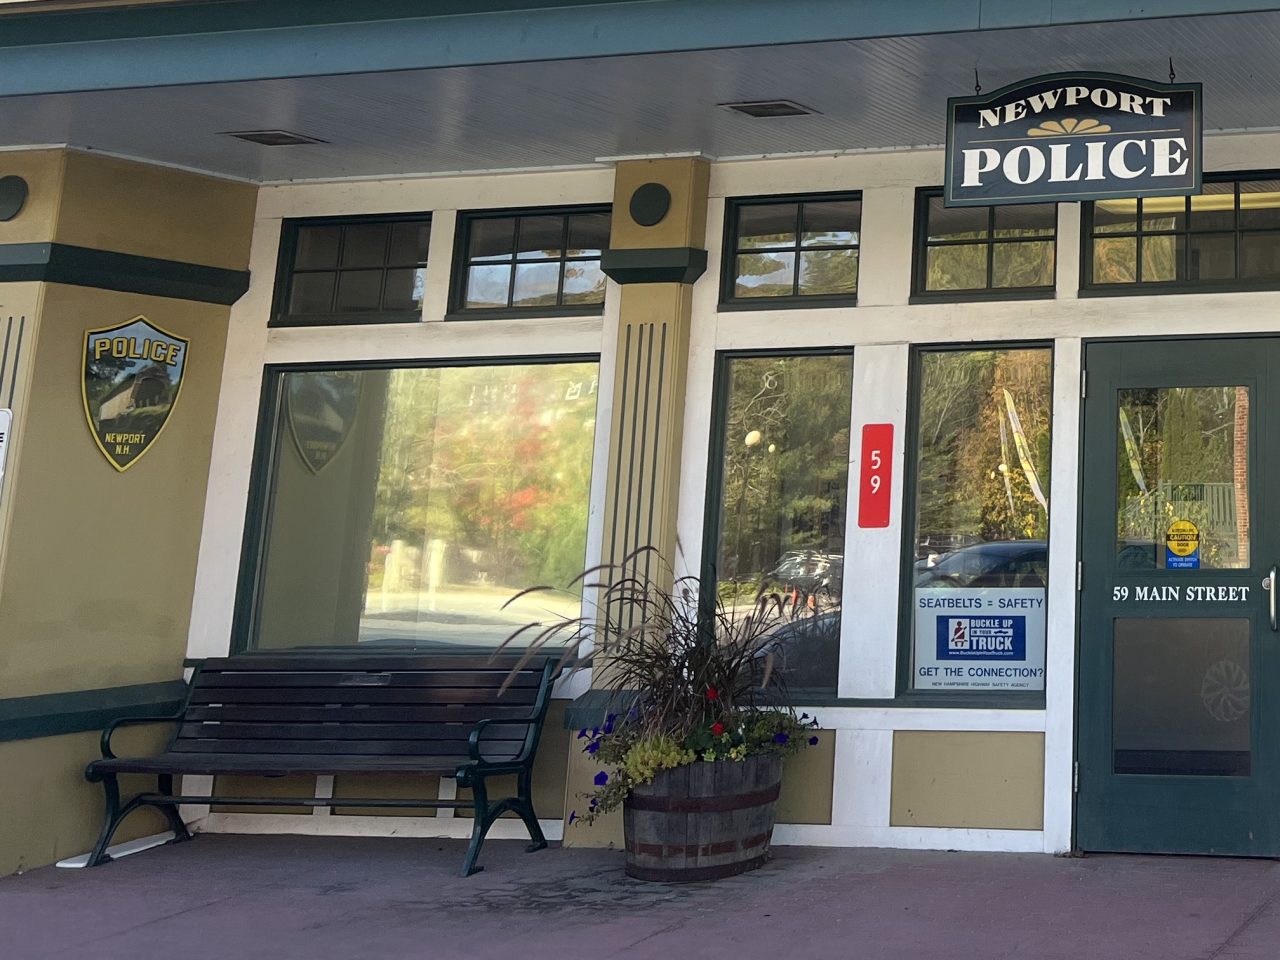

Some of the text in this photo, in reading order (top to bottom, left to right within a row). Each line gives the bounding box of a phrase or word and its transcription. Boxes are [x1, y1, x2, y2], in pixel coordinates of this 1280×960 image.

[977, 86, 1171, 129] NEWPORT
[961, 137, 1190, 188] POLICE
[94, 337, 181, 366] POLICE
[104, 432, 146, 444] NEWPORT
[1112, 586, 1250, 601] 59 MAIN STREET
[919, 598, 982, 608] SEATBELTS
[998, 598, 1043, 608] SAFETY
[970, 619, 1013, 628] BUCKLE UP
[970, 636, 1013, 650] TRUCK
[919, 667, 1043, 678] GET THE CONNECTION?
